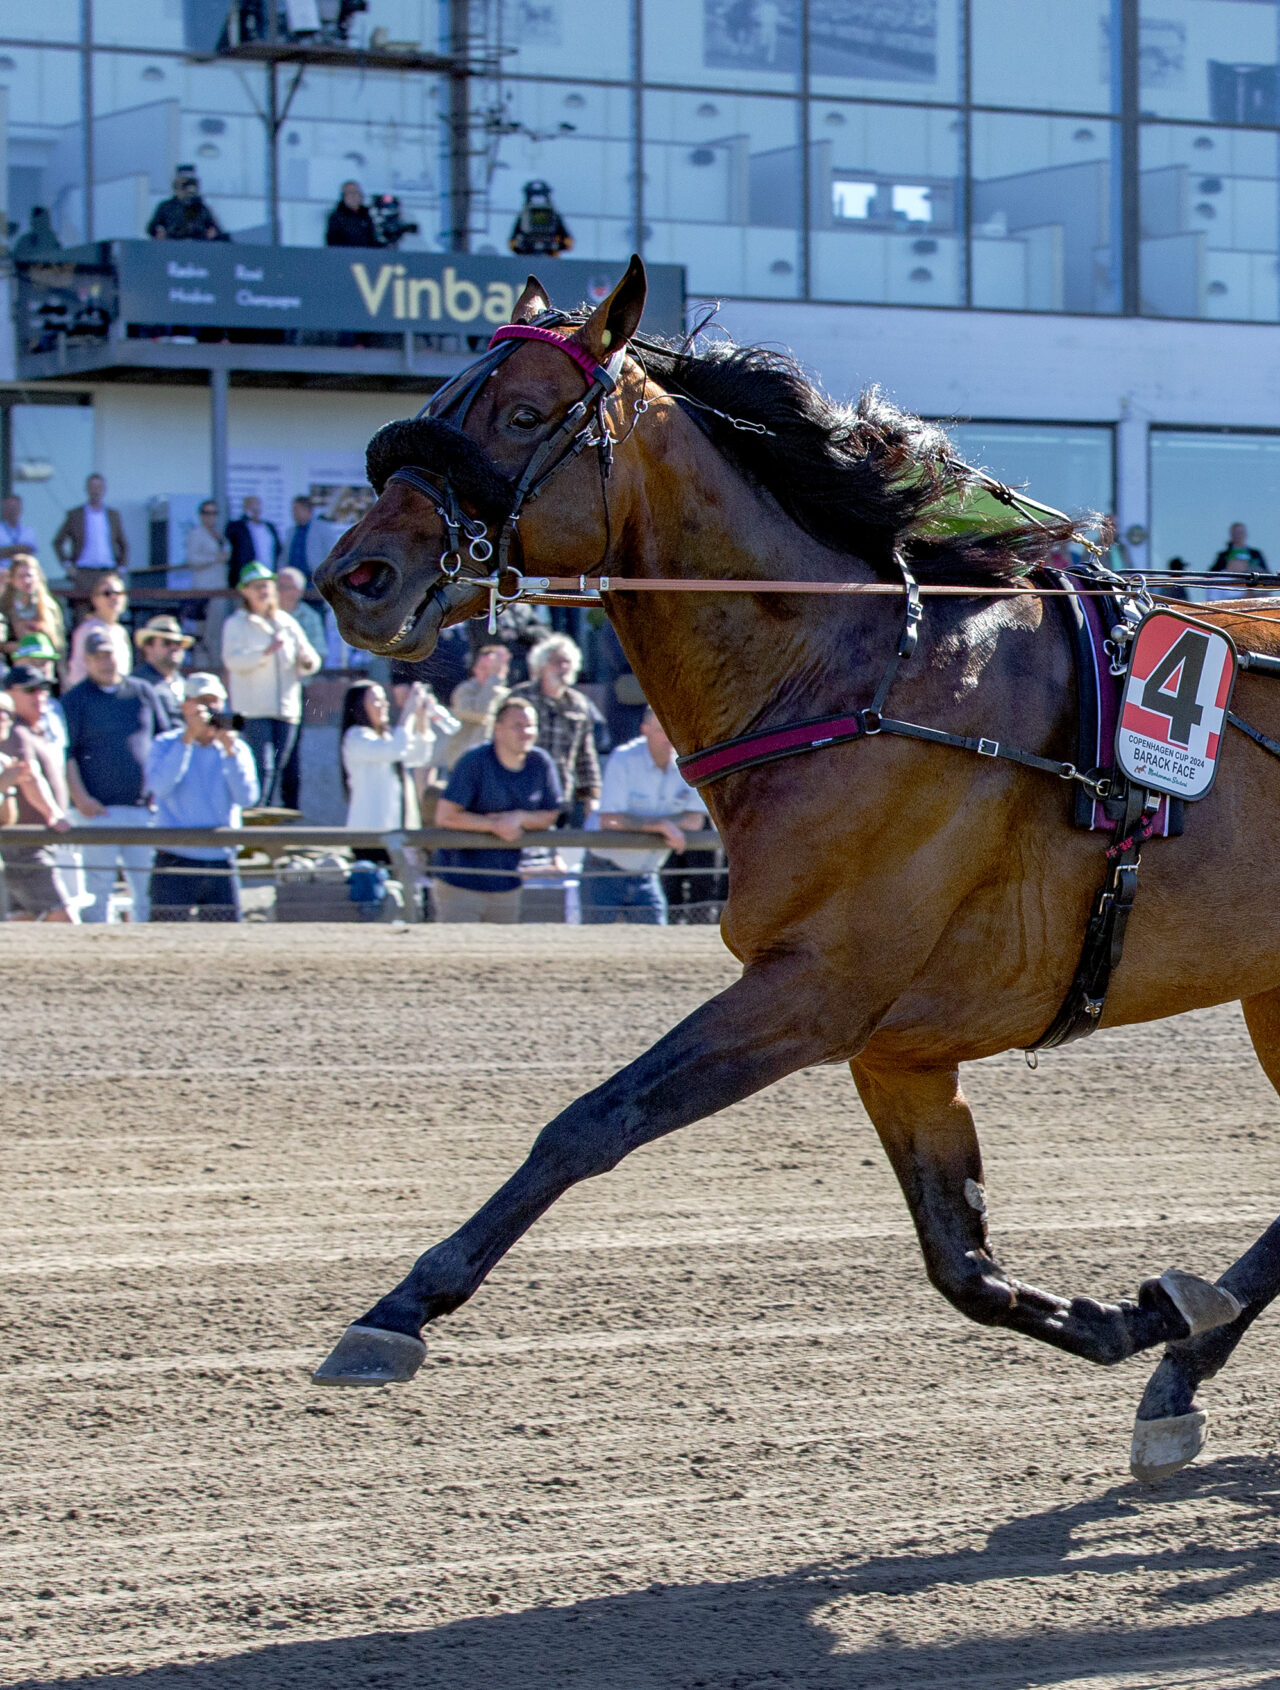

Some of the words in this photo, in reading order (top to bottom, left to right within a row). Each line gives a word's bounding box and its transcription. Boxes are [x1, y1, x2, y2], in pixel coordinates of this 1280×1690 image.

[1140, 628, 1210, 746] 4
[1128, 734, 1174, 758] COPENHAGEN
[1174, 751, 1189, 763] CUP
[1189, 756, 1205, 769] 2024
[1133, 747, 1171, 772] BARACK
[1171, 761, 1196, 780] FACE
